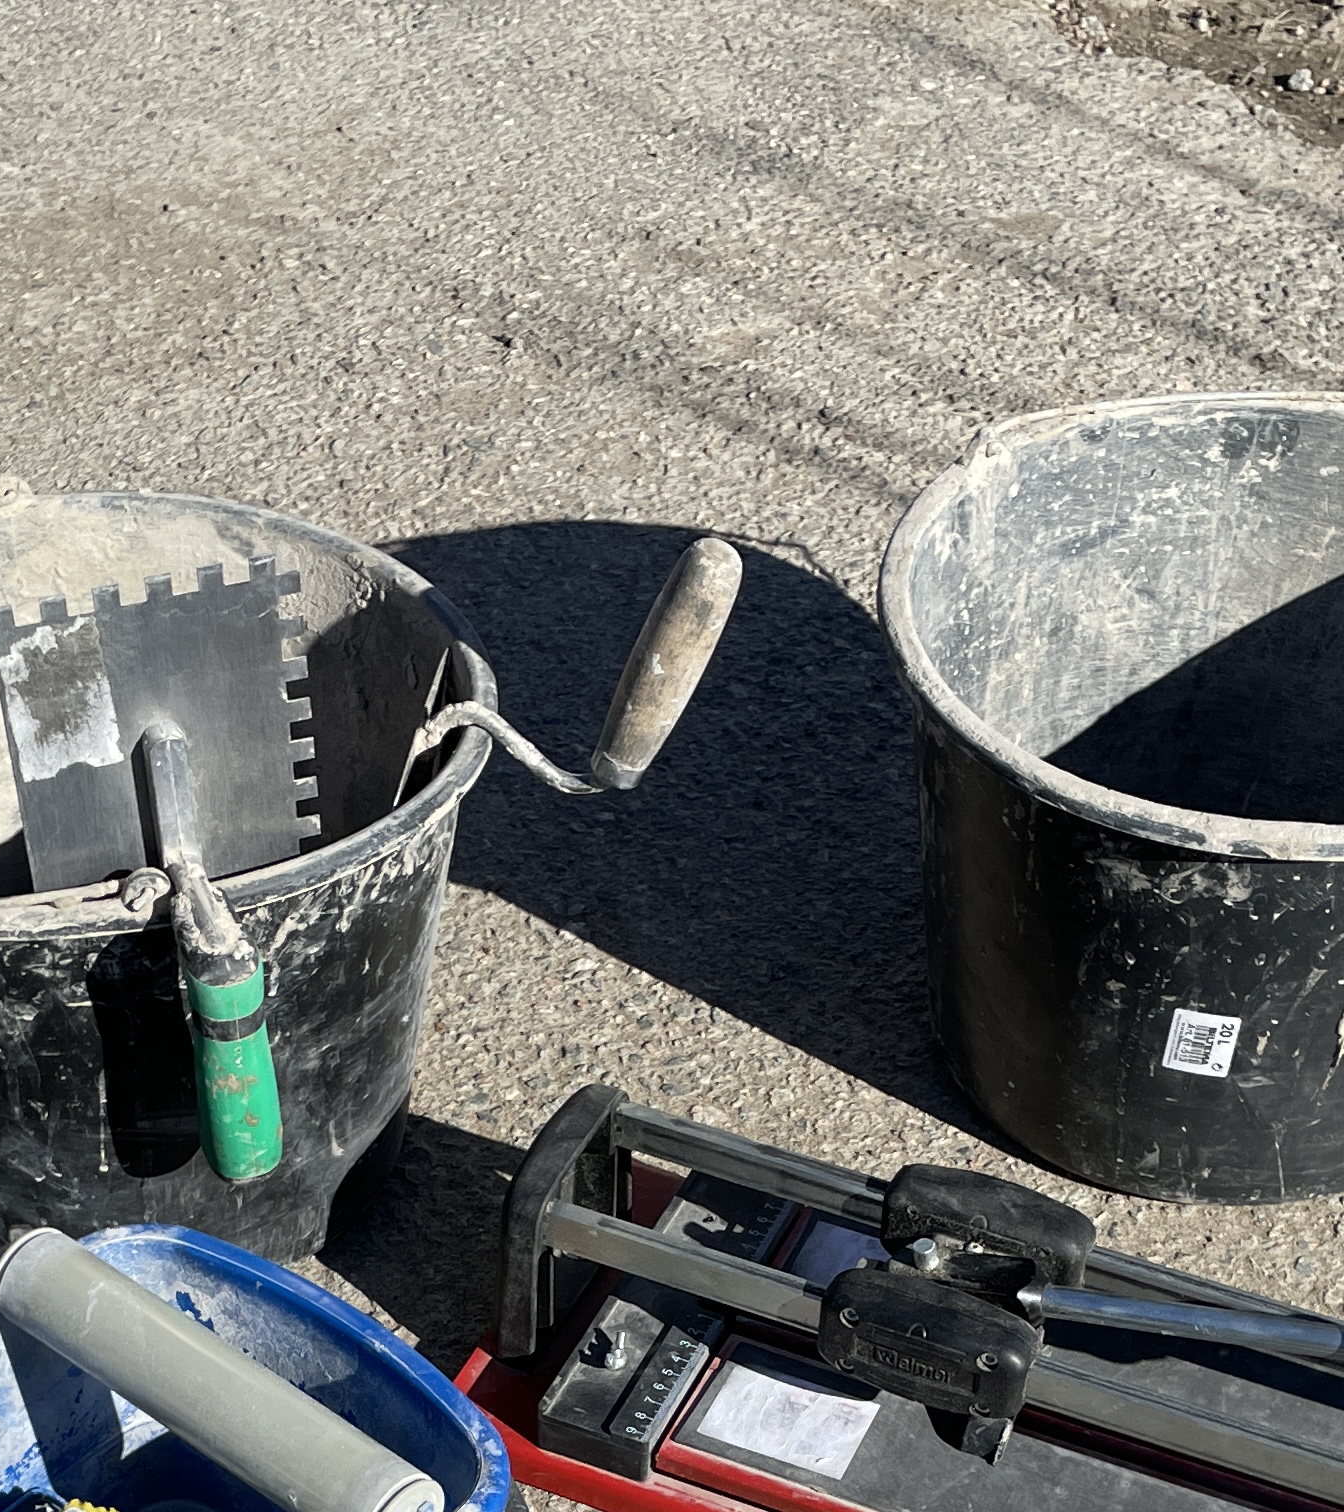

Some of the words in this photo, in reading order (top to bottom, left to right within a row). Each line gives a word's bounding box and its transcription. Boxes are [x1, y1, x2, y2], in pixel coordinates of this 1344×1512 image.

[1219, 1023, 1235, 1038] 20
[874, 1345, 956, 1384] Walmer
[661, 1368, 673, 1376] 5
[652, 1382, 664, 1391] 6
[634, 1411, 646, 1420] 8
[625, 1426, 637, 1434] 9
